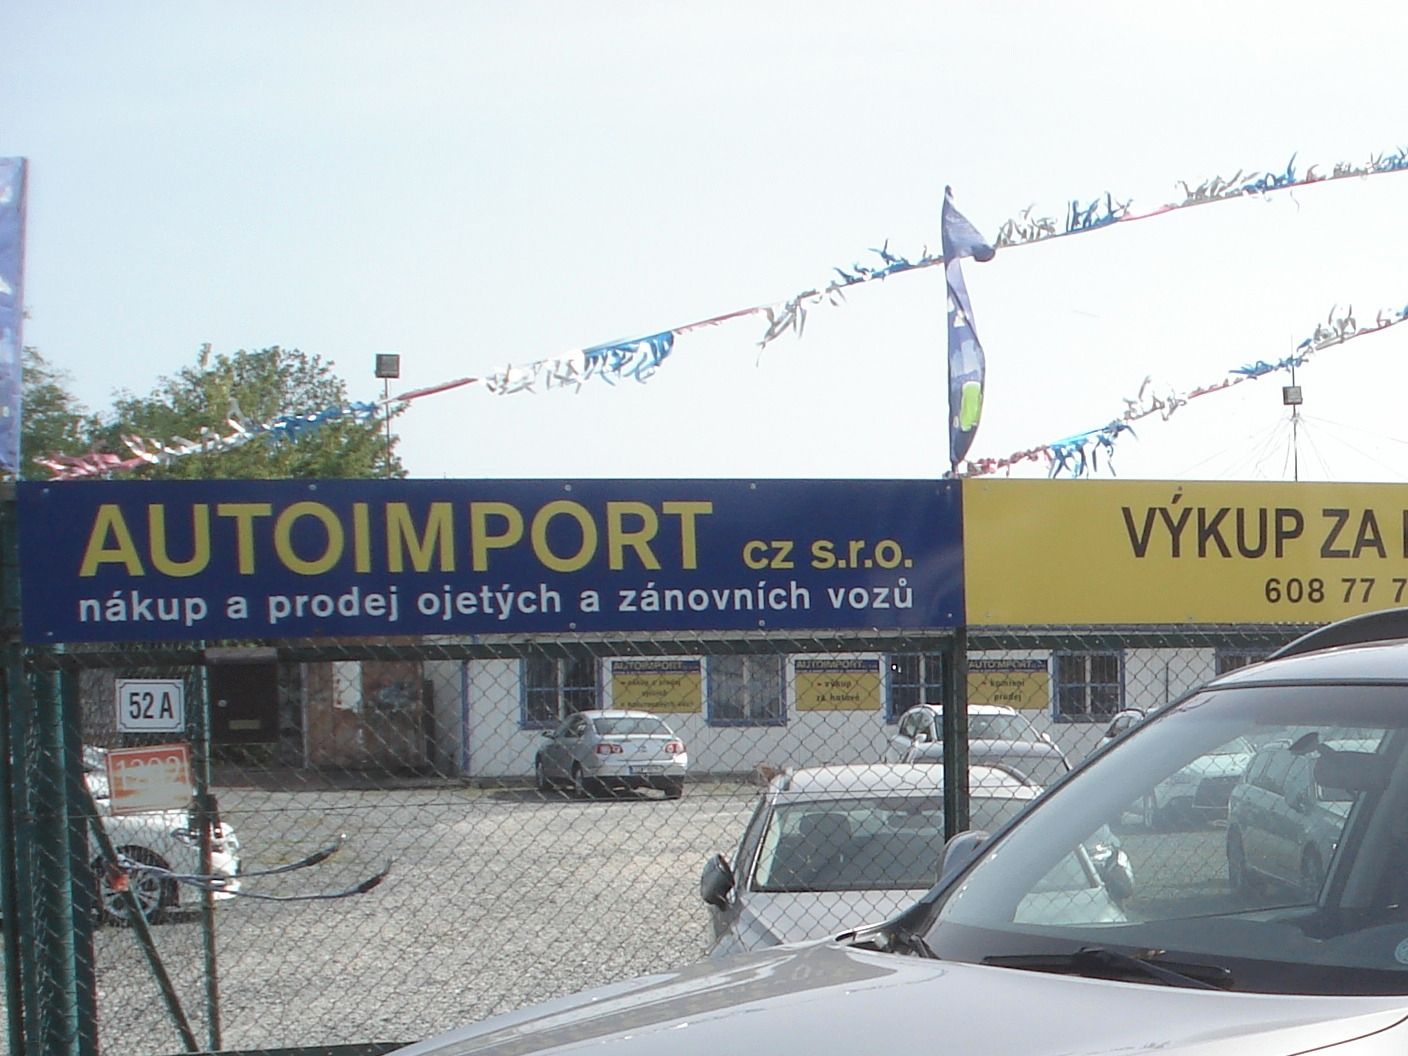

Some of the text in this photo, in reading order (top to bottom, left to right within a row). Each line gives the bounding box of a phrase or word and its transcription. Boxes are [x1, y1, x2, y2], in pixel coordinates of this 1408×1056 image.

[79, 499, 913, 578] AUTOIMPORT cz s.r.o.
[1121, 493, 1305, 559] VÝKUP
[1319, 509, 1387, 559] ZA
[79, 577, 914, 626] nákup a prodej ojetých a zánovních vozů
[1265, 577, 1325, 603] 608
[1341, 577, 1378, 603] 77
